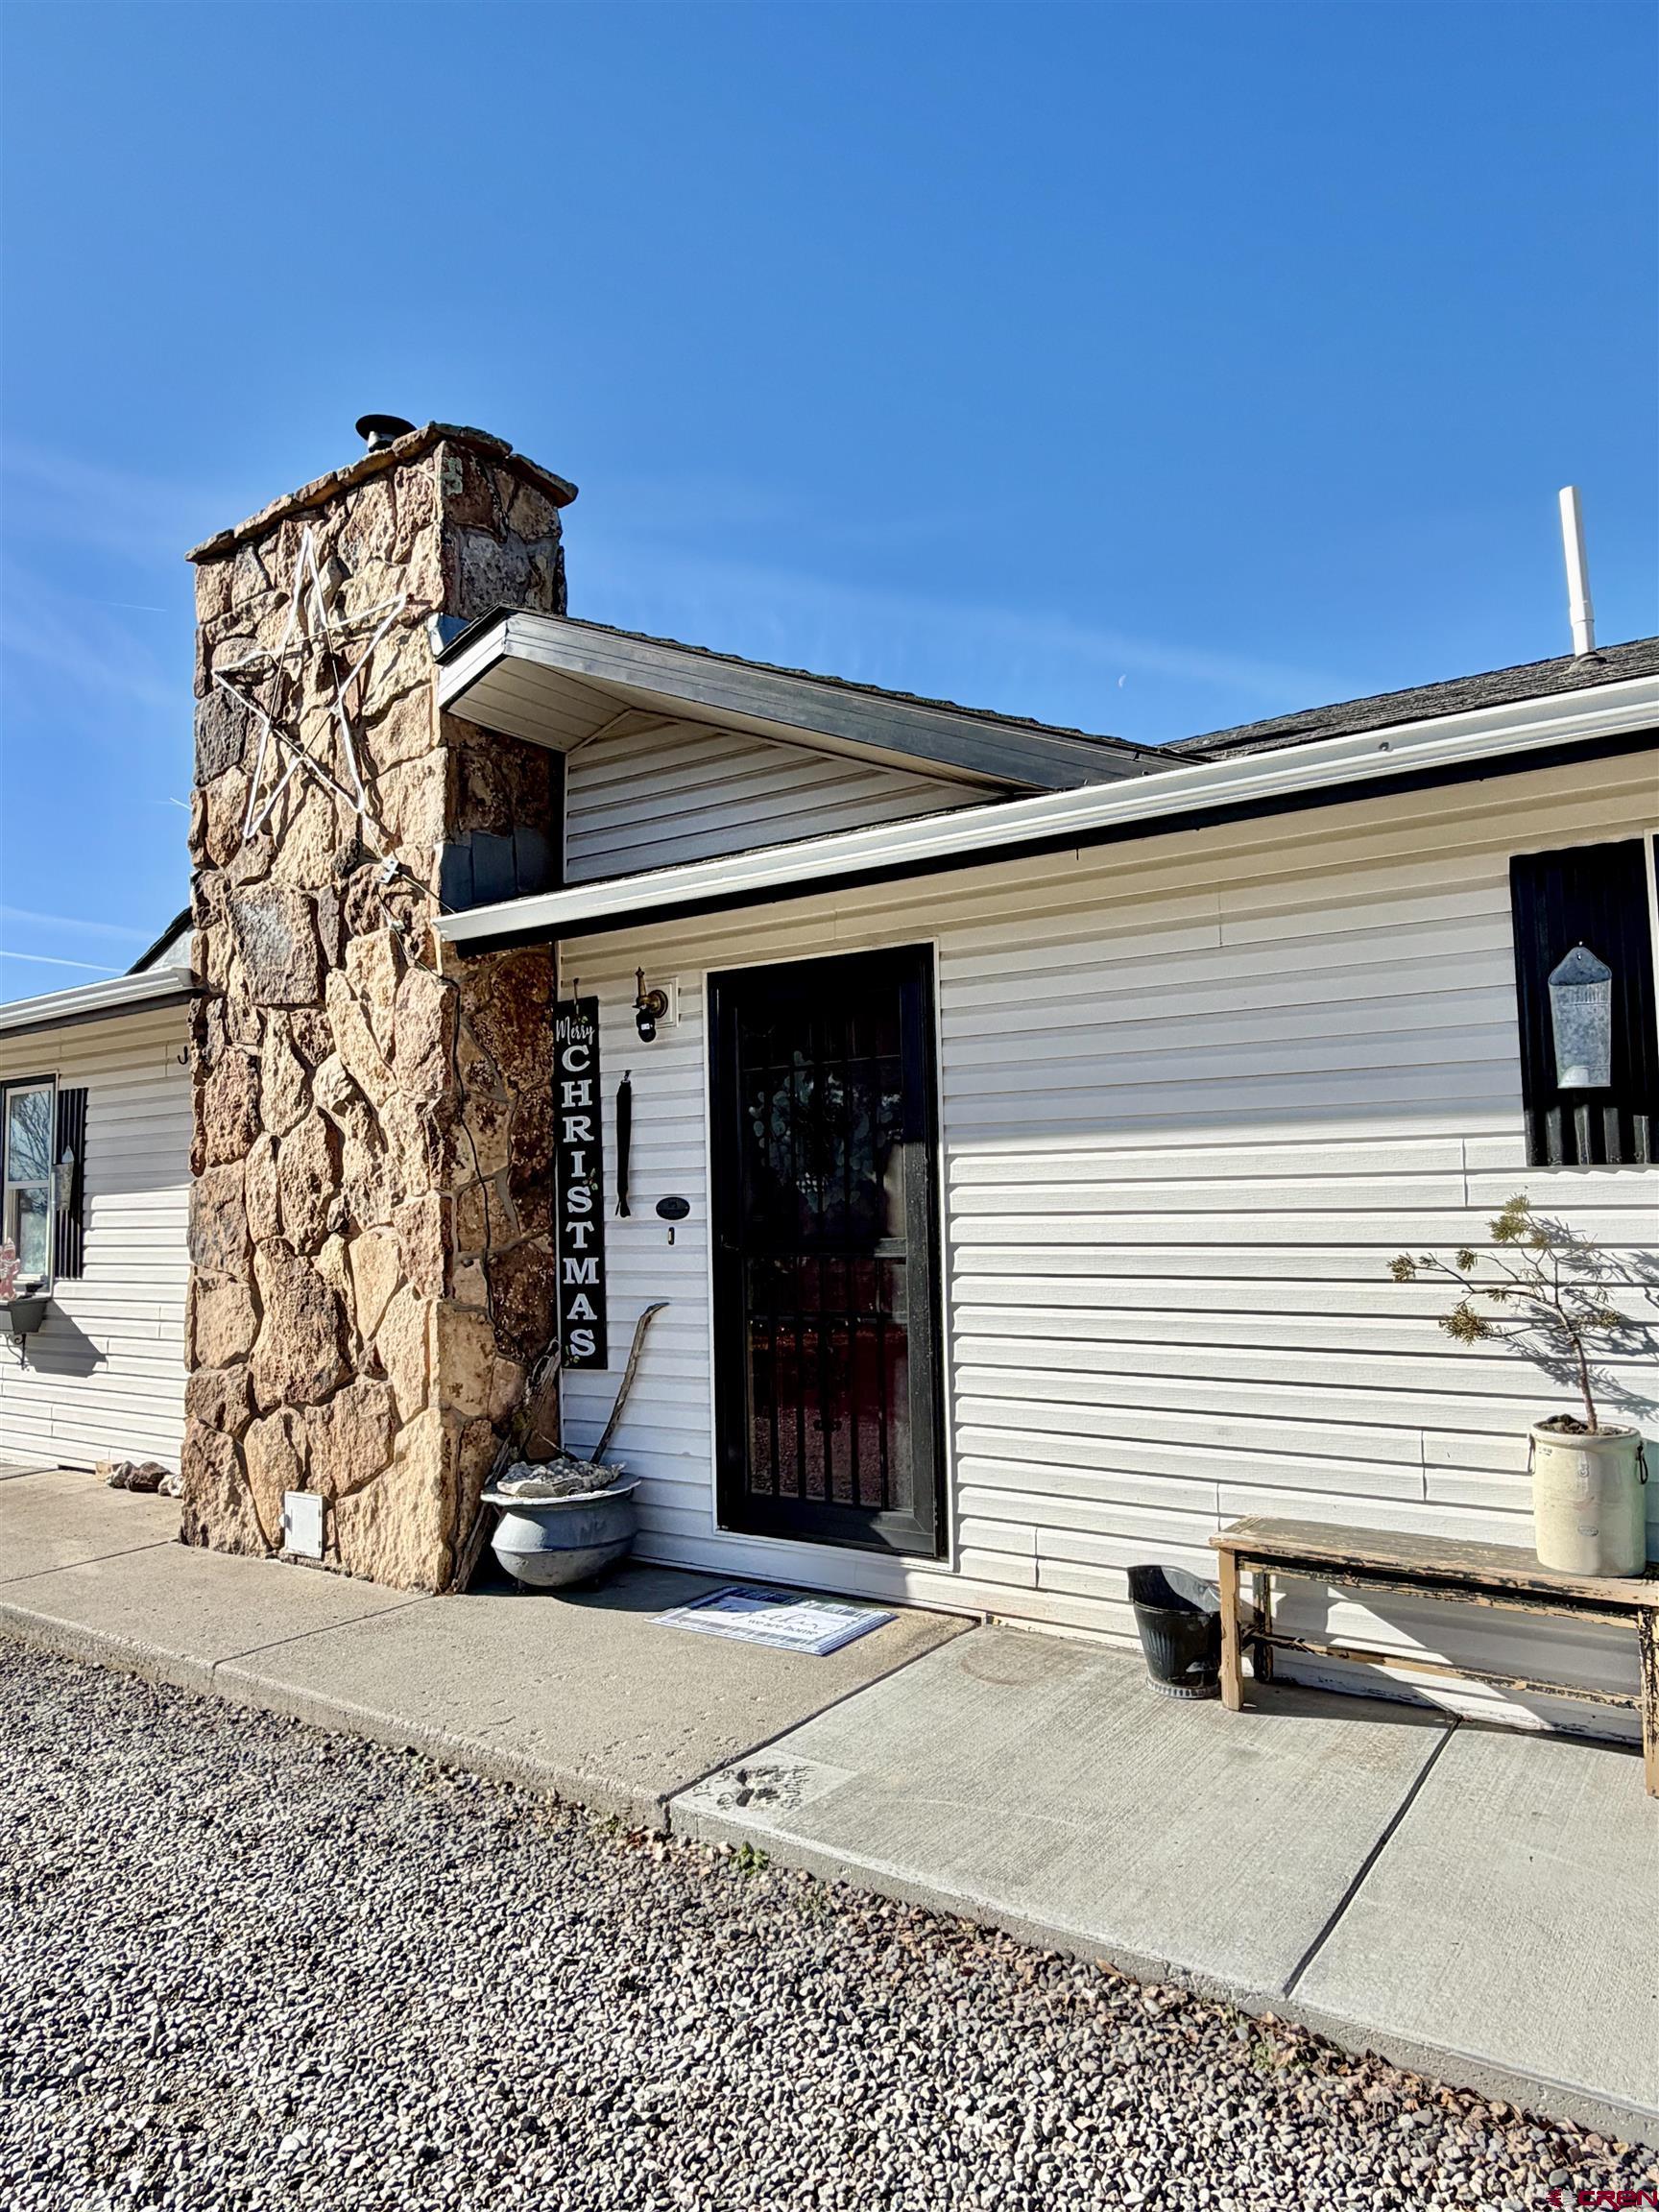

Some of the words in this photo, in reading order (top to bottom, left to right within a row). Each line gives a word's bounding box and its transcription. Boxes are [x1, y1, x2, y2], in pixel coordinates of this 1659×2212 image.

[556, 1016, 595, 1045] Merry
[561, 1045, 600, 1358] CHRISTMAS
[783, 1624, 818, 1635] home
